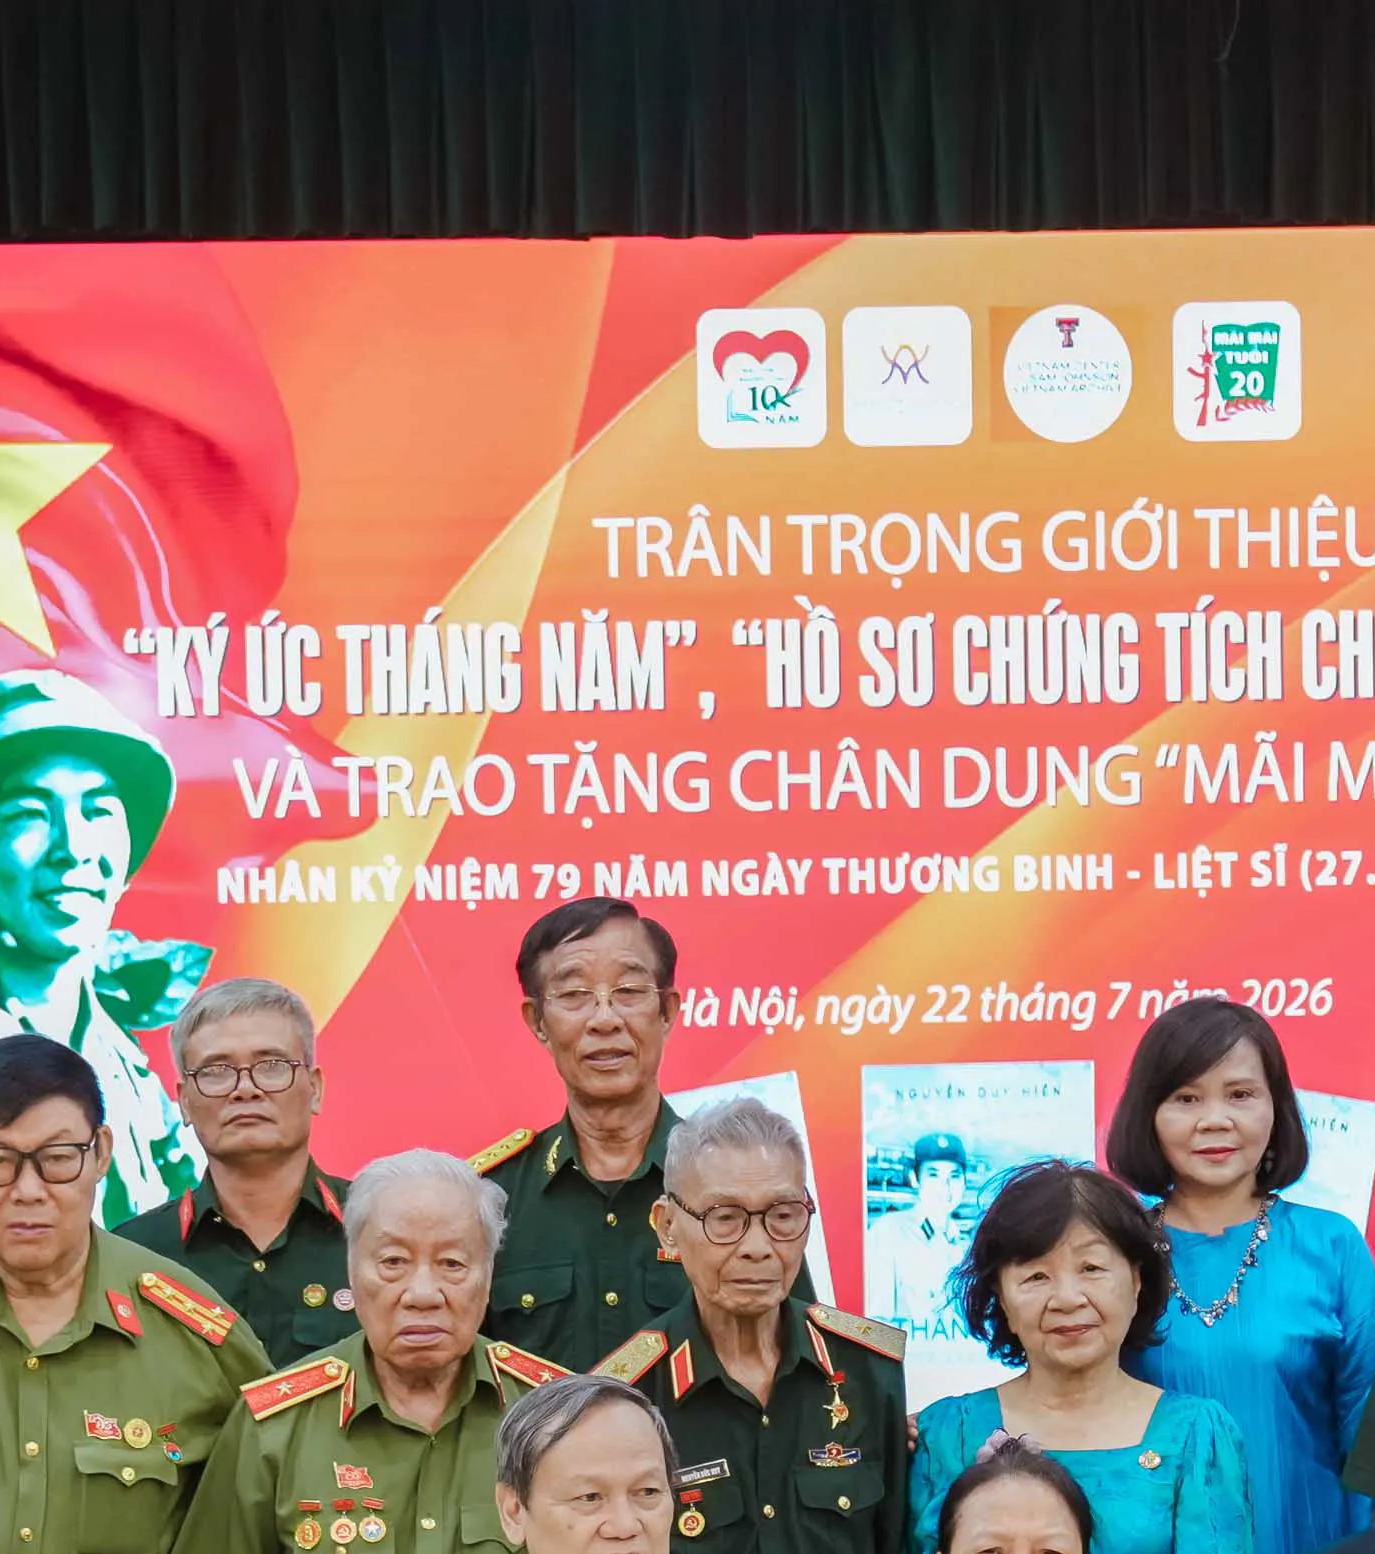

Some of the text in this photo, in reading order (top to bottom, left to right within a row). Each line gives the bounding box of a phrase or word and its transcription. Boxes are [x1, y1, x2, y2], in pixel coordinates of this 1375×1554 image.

[1229, 369, 1265, 397] 20
[593, 503, 771, 578] TRÂN
[786, 512, 1022, 589] TRỌNG
[1042, 497, 1178, 572] GIỚI
[123, 611, 227, 717] “KÝ
[245, 609, 321, 716] ỨC
[336, 606, 522, 715] THÁNG
[732, 595, 840, 708] “HỒ
[859, 612, 935, 707] SƠ
[952, 596, 1139, 706] CHỨNG
[1155, 594, 1282, 702] TÍCH
[232, 742, 321, 819] VÀ
[332, 753, 516, 818] TRAO
[527, 740, 710, 829] TẶNG
[730, 736, 920, 812] CHÂN
[944, 744, 1141, 808] DUNG
[1155, 730, 1304, 805] “MÃI
[217, 857, 337, 904] NHÂN
[350, 852, 403, 903] KỶ
[414, 857, 519, 910] NIỆM
[532, 863, 581, 899] 79
[594, 854, 688, 898] NĂM
[702, 852, 813, 897] NGÀY
[822, 851, 1000, 895] THƯƠNG
[1013, 853, 1113, 892] BINH
[1127, 870, 1141, 879] -
[1154, 844, 1239, 898] LIỆT
[1251, 843, 1288, 888] SĨ
[729, 985, 806, 1035] Nội,
[816, 984, 916, 1035] ngày
[921, 984, 971, 1023] 22
[980, 981, 1096, 1031] tháng
[1107, 981, 1132, 1020] 7
[1242, 978, 1333, 1017] 2026
